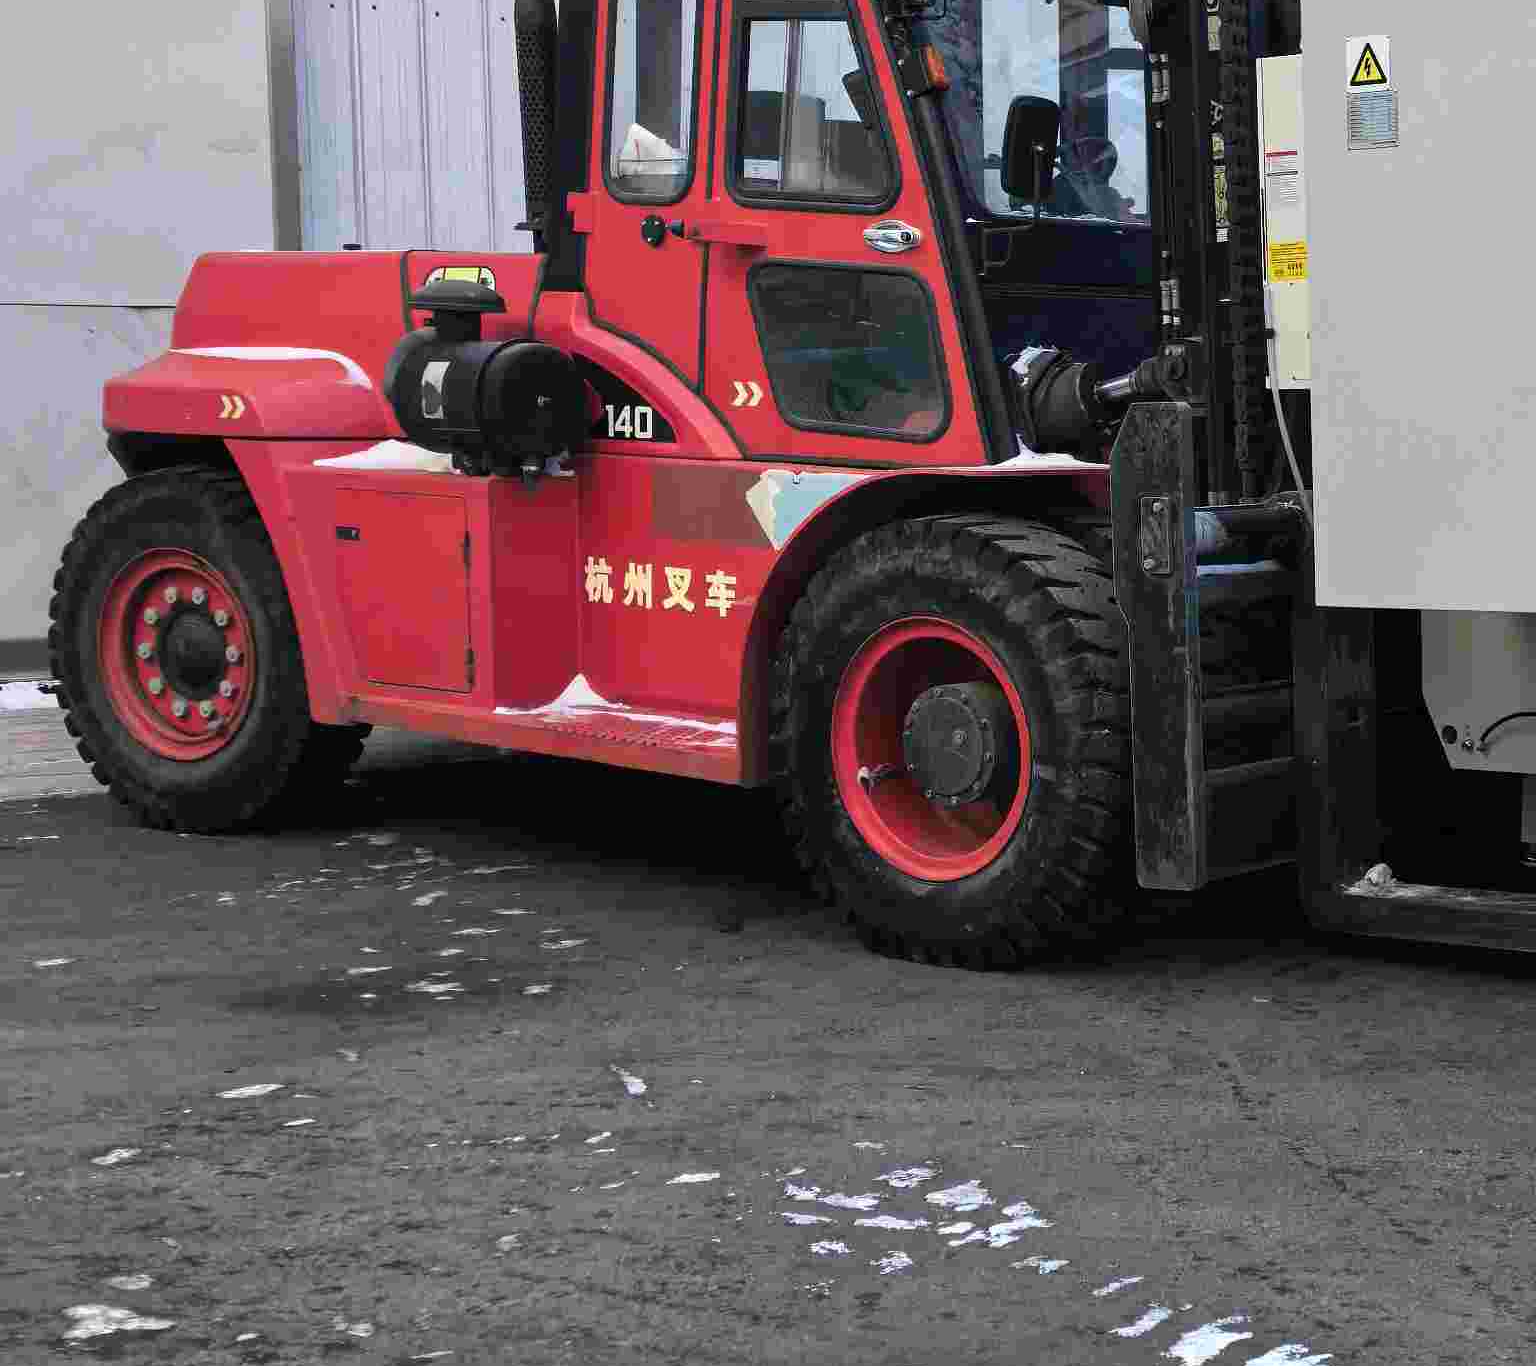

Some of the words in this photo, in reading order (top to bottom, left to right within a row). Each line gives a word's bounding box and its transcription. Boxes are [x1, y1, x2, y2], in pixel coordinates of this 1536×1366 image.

[605, 405, 653, 439] 140
[584, 555, 737, 617] 杭州叉车
